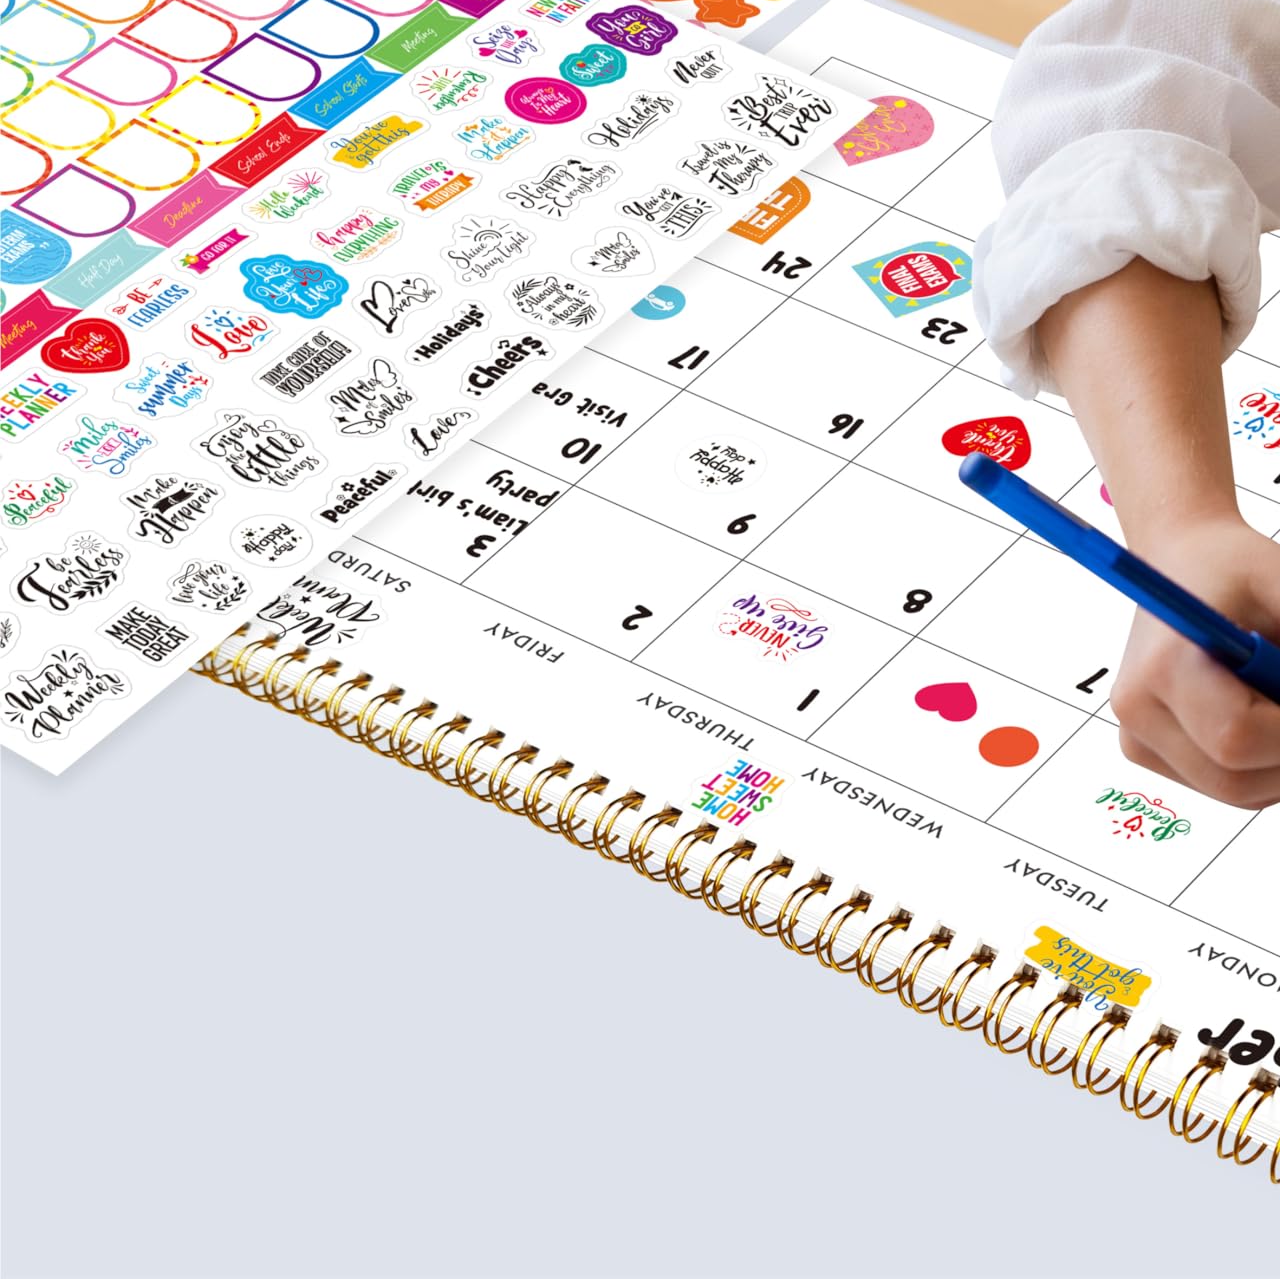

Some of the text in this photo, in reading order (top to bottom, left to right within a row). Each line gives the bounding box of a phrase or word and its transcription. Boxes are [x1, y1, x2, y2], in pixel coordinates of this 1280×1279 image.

[545, 7, 568, 23] IN
[597, 11, 641, 35] You
[401, 27, 437, 53] Meeting
[473, 24, 511, 49] Seize
[495, 36, 537, 65] Day
[625, 21, 667, 49] Girl
[571, 50, 614, 80] Sweet
[673, 50, 717, 84] Never
[700, 63, 723, 80] QUIT
[315, 75, 368, 117] School Starts
[432, 70, 487, 111] Remember
[540, 93, 572, 117] Heart
[733, 82, 788, 122] Best
[587, 93, 674, 148] Holidays
[748, 98, 833, 147] Ever
[774, 102, 798, 120] TRIP
[330, 119, 389, 153] You've
[355, 126, 411, 166] got this
[457, 118, 502, 143] Make
[471, 127, 529, 161] Happen
[237, 132, 291, 174] School Ends
[682, 140, 731, 175] Travel is
[392, 161, 447, 194] TRAVEL IS
[506, 164, 575, 209] Happy
[545, 164, 617, 208] Everything
[708, 152, 773, 195] Therapy
[259, 190, 290, 212] Hello
[274, 184, 324, 220] Weekend
[426, 180, 466, 206] THERAPY
[622, 187, 671, 222] You've
[317, 212, 374, 247] happy
[665, 203, 703, 230] THIS
[0, 239, 35, 263] EXAMS
[200, 236, 237, 261] GO FOR IT
[333, 217, 400, 262] EVERYTHING
[448, 241, 488, 270] Shine
[78, 253, 121, 289] Half Day
[252, 261, 291, 283] Love
[761, 251, 812, 279] 24
[888, 265, 922, 294] FINAL
[908, 255, 948, 288] EXAMS
[127, 287, 153, 305] BE
[128, 283, 189, 327] FEARLESS
[292, 279, 337, 312] Life
[521, 276, 561, 314] Always
[544, 290, 573, 312] in my
[555, 297, 586, 323] heart
[0, 319, 38, 348] Meeting
[191, 315, 268, 360] Love
[416, 307, 484, 359] Holidays
[921, 317, 968, 345] 23
[259, 330, 332, 386] TAKE CARE OF
[275, 340, 352, 398] YOURSELF!
[468, 335, 543, 389] Cheers
[667, 346, 710, 370] 17
[125, 367, 161, 393] Sweet
[139, 361, 195, 417] summer
[170, 386, 202, 408] Days
[0, 382, 77, 437] PLANNER
[364, 390, 413, 429] Smiles
[577, 398, 629, 428] Visit
[828, 413, 865, 439] 16
[200, 419, 258, 457] Enjoy
[411, 411, 472, 457] Love
[92, 431, 153, 475] Smiles
[226, 452, 247, 464] the
[230, 434, 305, 482] little
[561, 438, 602, 465] 10
[689, 447, 743, 485] Happy
[720, 445, 746, 463] day
[268, 454, 320, 487] things
[3, 476, 73, 526] Peaceful
[126, 477, 178, 509] Make
[320, 470, 393, 523] Peaceful
[486, 470, 560, 508] party
[135, 487, 219, 544] Happen
[457, 498, 529, 536] Liam's
[727, 513, 757, 535] 9
[243, 523, 295, 555] Happy
[273, 541, 295, 558] day
[466, 535, 497, 558] 3
[17, 547, 124, 611] Fearless
[46, 557, 73, 572] be
[192, 563, 227, 587] your
[198, 583, 230, 600] life
[902, 589, 933, 613] 8
[105, 605, 153, 640] MAKE
[121, 615, 170, 652] TODAY
[622, 604, 653, 631] 2
[732, 594, 829, 651] Give up
[739, 618, 791, 649] NEVER
[142, 626, 190, 662] GREAT
[484, 623, 565, 663] FRIDAY
[4, 657, 94, 711] Weekly
[1075, 667, 1109, 694] 7
[32, 673, 121, 739] Planner
[797, 688, 821, 712] 1
[637, 692, 755, 751] THURSDAY
[701, 773, 773, 812] SWEET
[725, 759, 785, 795] HOME
[691, 790, 752, 827] HOME
[801, 767, 944, 839] WEDNESDAY
[1095, 786, 1192, 842] Peaceful
[1004, 858, 1109, 913] TUESDAY
[1053, 937, 1143, 986] got this
[1040, 958, 1116, 1011] You've
